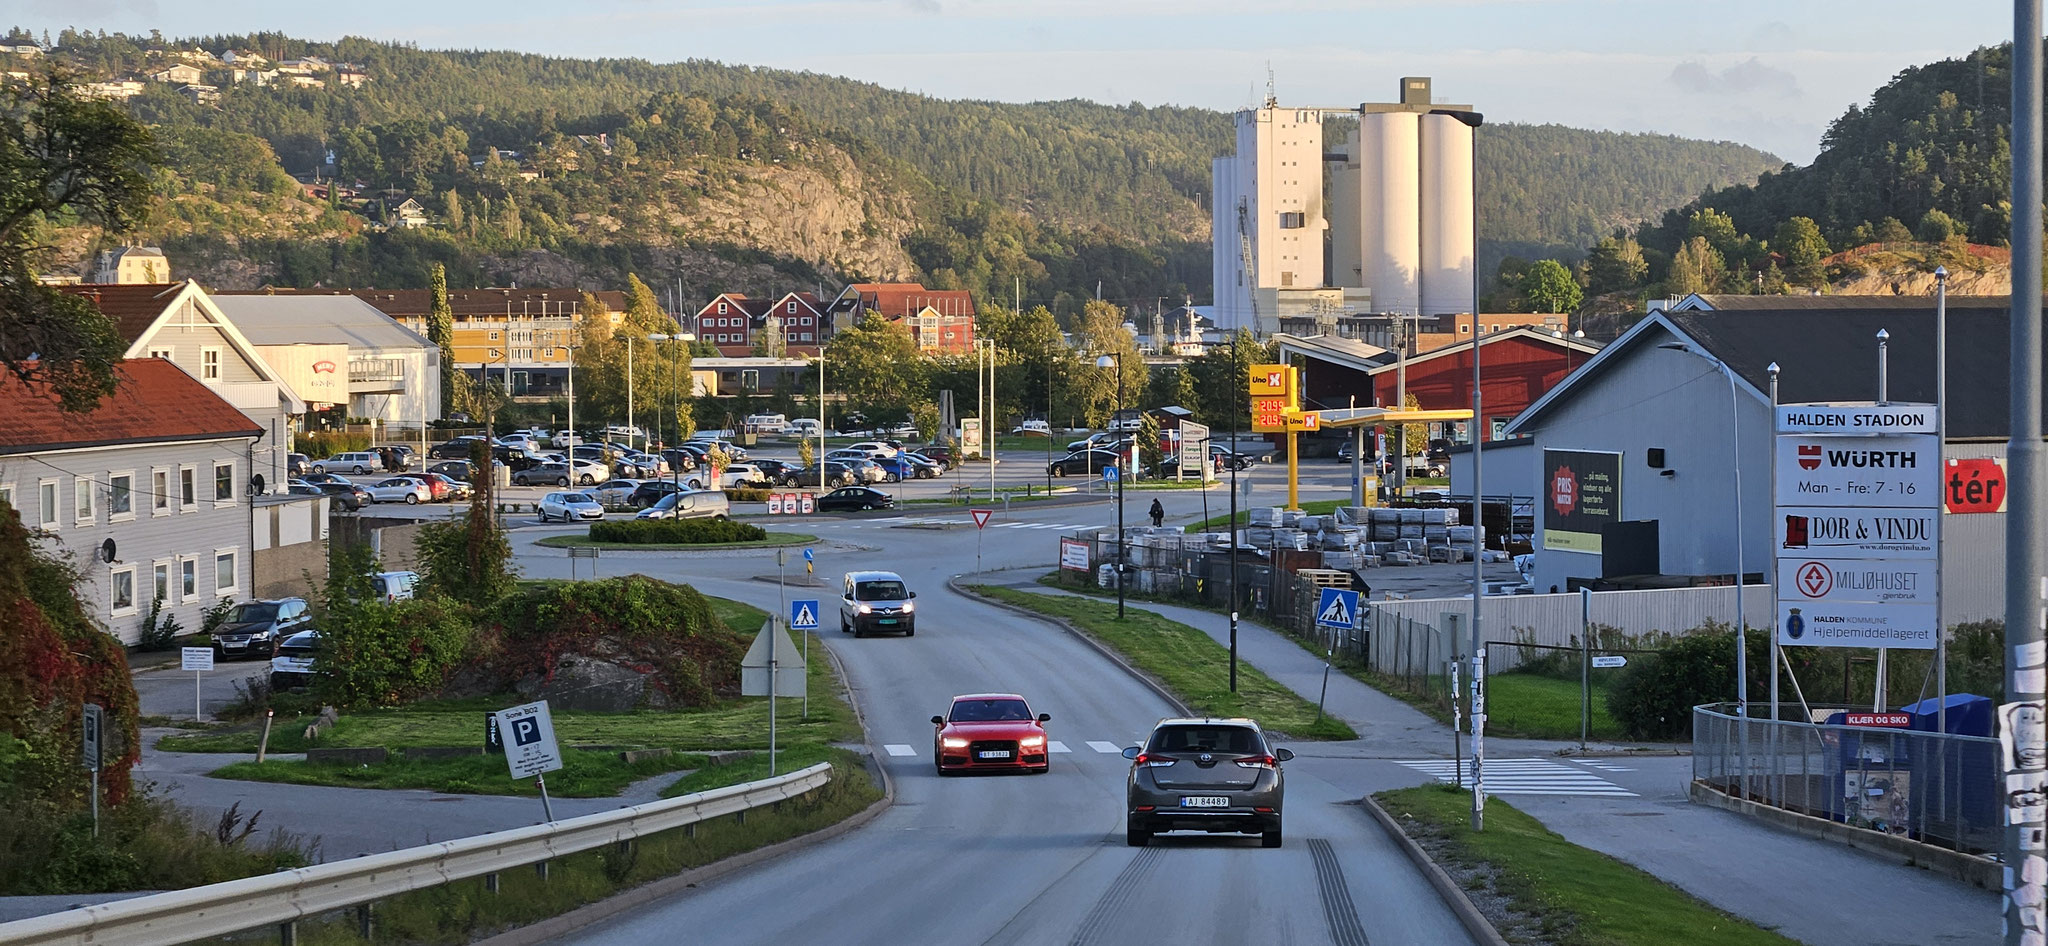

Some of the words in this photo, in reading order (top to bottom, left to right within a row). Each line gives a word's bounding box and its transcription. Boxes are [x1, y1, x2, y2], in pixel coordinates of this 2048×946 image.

[1252, 376, 1267, 384] Uno
[1787, 413, 1846, 427] HALDEN
[1853, 414, 1925, 427] STADION
[1828, 450, 1917, 469] WÜRTH
[1557, 477, 1572, 494] PRIS
[1798, 481, 1829, 494] Man
[1847, 481, 1871, 494] Fre:
[1875, 481, 1886, 494] 7
[1899, 481, 1917, 495] 16
[1557, 494, 1572, 505] MATCH
[1813, 517, 1850, 540] DØR
[1855, 519, 1869, 540] &
[1875, 517, 1932, 541] VINDU
[1836, 571, 1918, 591] MILJØHUSET
[1882, 592, 1917, 600] gjenbruk
[1814, 615, 1845, 624] HALDEN
[1846, 616, 1888, 625] KOMMUNE
[1813, 627, 1929, 641] Hjelpemiddellageret
[505, 711, 523, 720] Sone
[1848, 716, 1874, 724] KLÆR
[1876, 716, 1888, 724] OG
[1890, 716, 1908, 725] SKO
[517, 721, 533, 743] P
[1188, 797, 1198, 806] AJ
[1200, 797, 1227, 806] 84489
